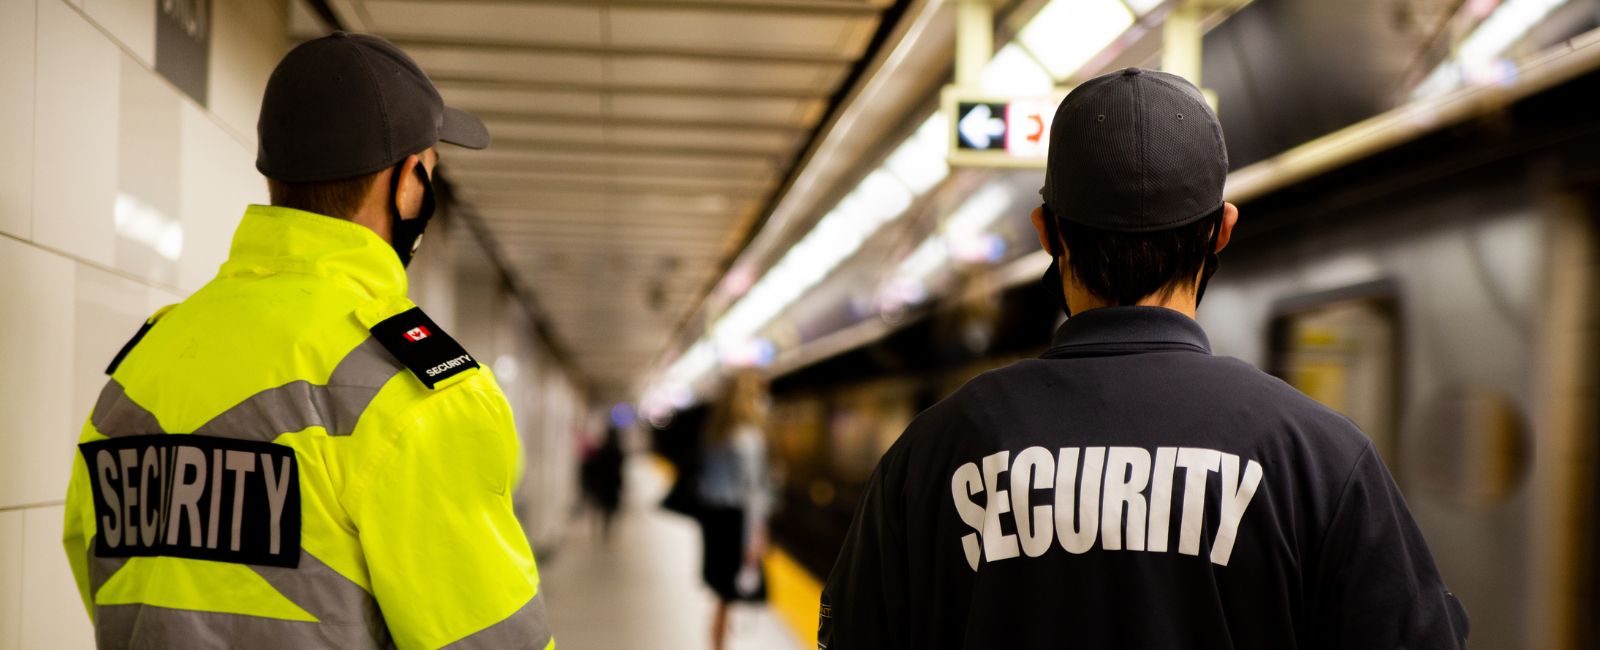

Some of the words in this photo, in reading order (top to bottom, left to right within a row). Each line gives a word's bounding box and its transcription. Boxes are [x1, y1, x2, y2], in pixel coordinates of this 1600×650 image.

[426, 354, 471, 377] SECURITY
[96, 445, 291, 555] SECURITY
[951, 446, 1263, 572] SECURITY
